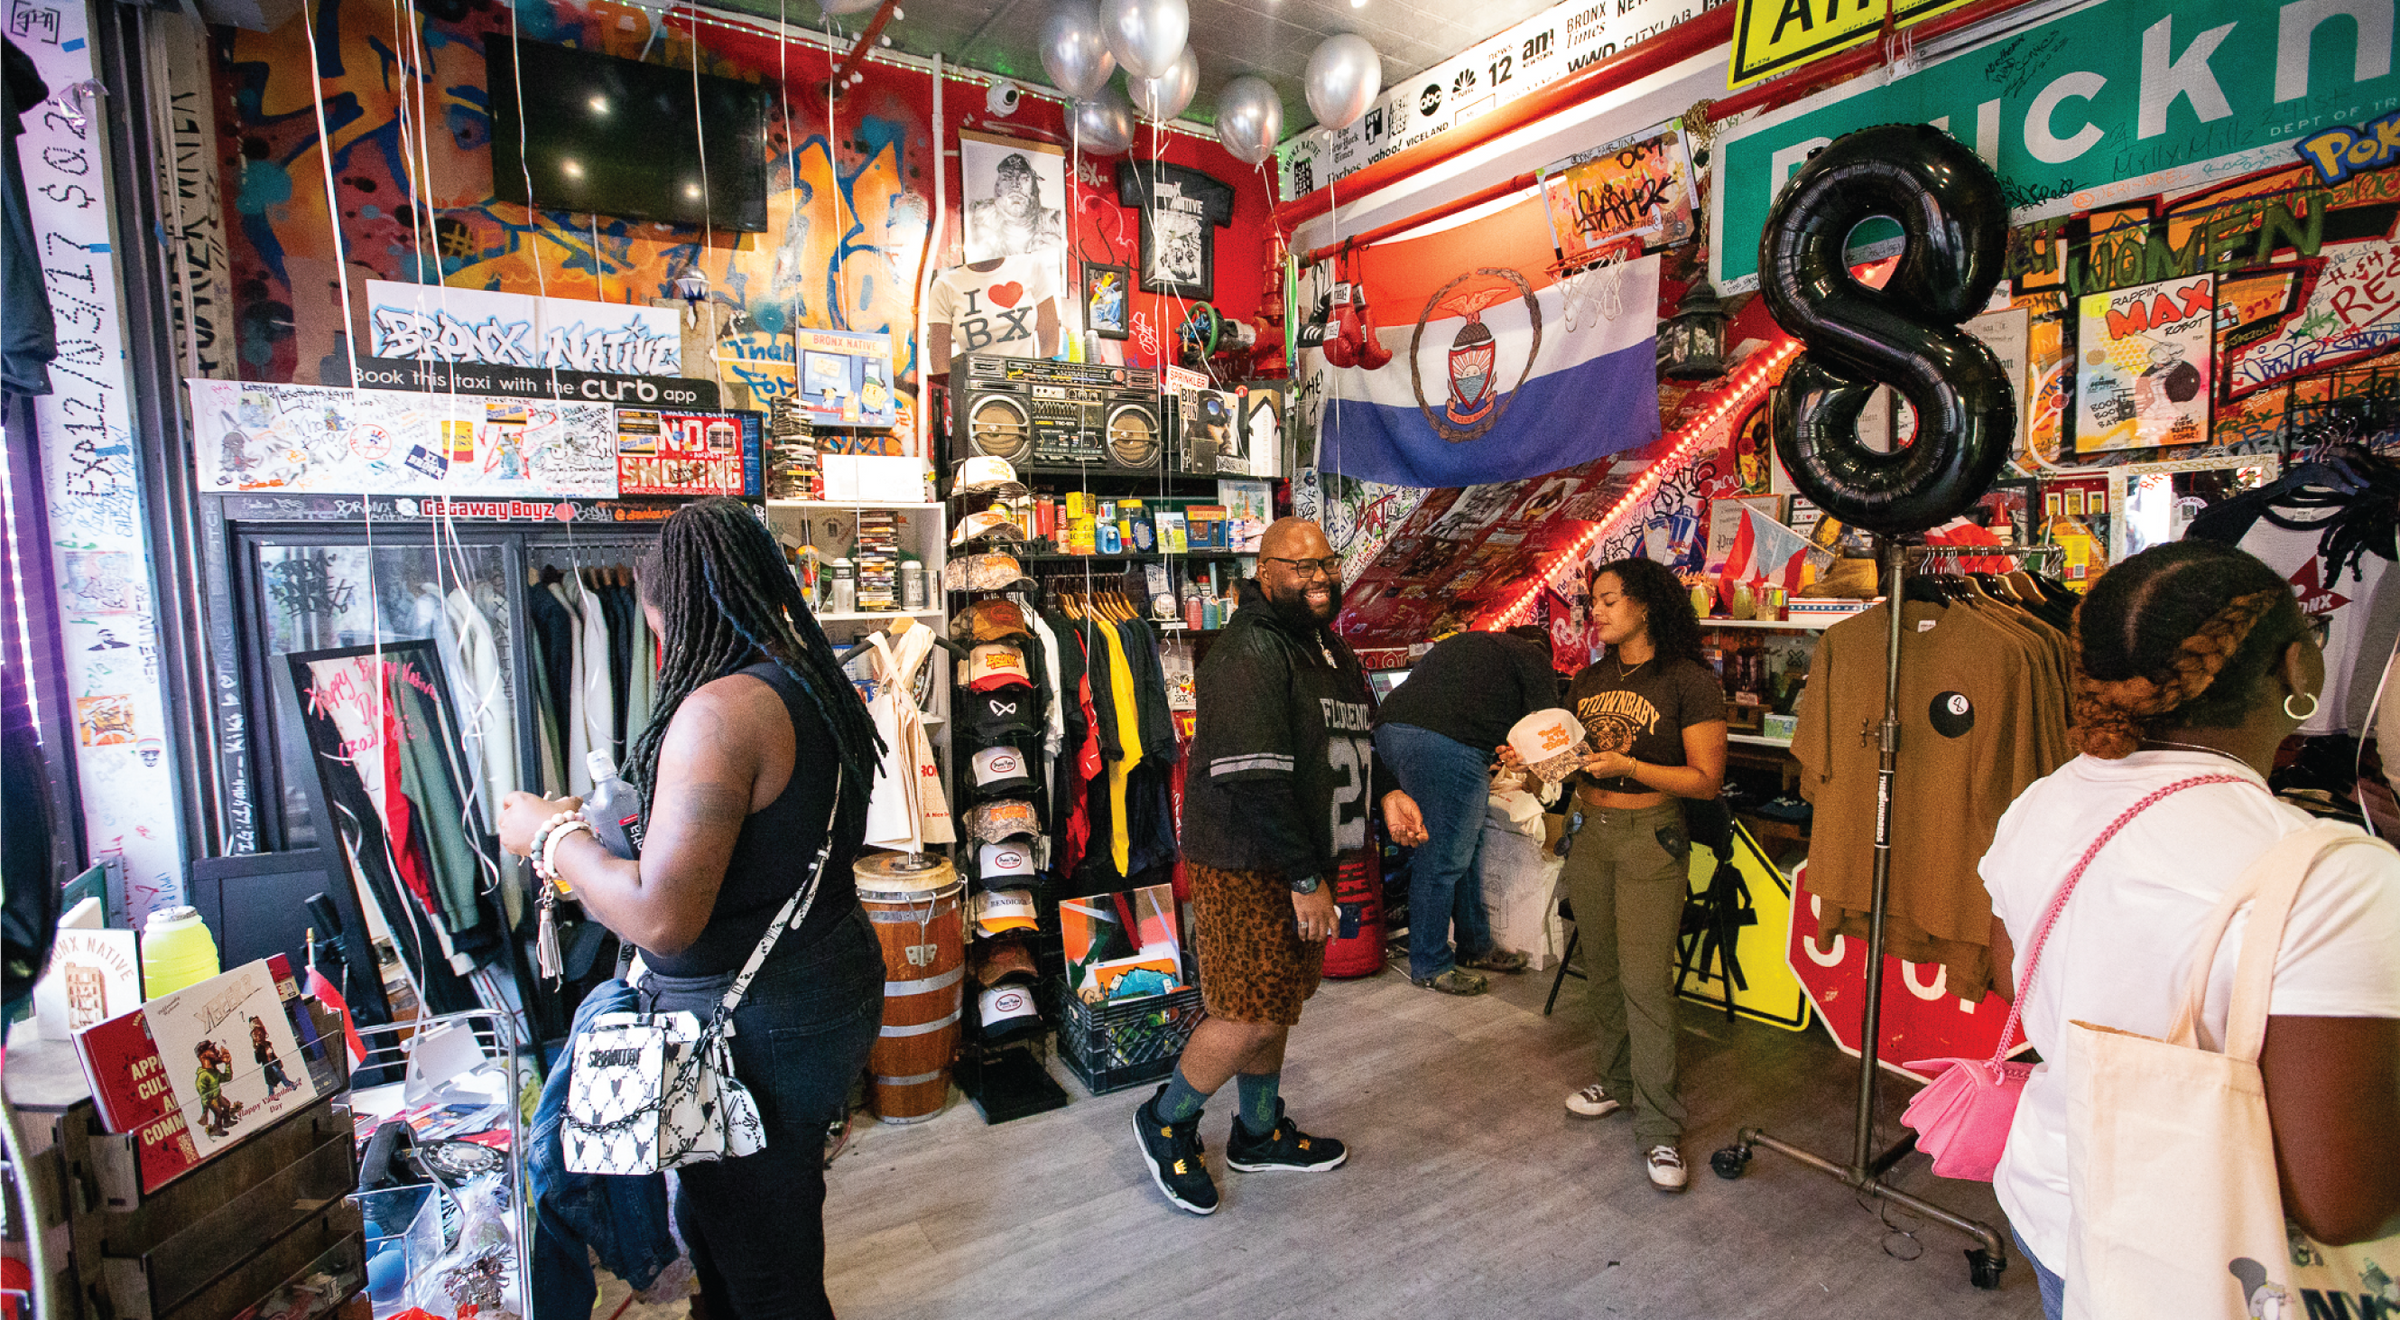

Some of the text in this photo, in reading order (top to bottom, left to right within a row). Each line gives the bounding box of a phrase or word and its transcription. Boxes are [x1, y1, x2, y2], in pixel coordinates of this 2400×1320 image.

[1567, 3, 1607, 33] BRONX
[1488, 55, 1513, 87] 12
[1420, 90, 1441, 110] abc
[1406, 122, 1449, 147] VICELAND
[2270, 115, 2321, 137] DEPT
[2334, 106, 2361, 121] OF
[1284, 146, 1300, 173] BRONX
[1367, 139, 1403, 165] yahoo!
[963, 288, 982, 317] I
[2105, 279, 2214, 341] MAX
[371, 303, 681, 378] BRONX NATIVE
[957, 305, 1033, 352] BX
[1760, 123, 2017, 532] 8
[2165, 314, 2210, 337] ROBOT
[813, 334, 877, 351] BRONX NATIVE
[412, 366, 447, 386] this
[454, 371, 492, 390] taxi
[499, 375, 538, 393] with
[545, 378, 574, 395] the
[581, 378, 659, 401] curb
[663, 388, 698, 405] app
[1170, 370, 1206, 388] SPRINKLER
[1181, 388, 1198, 403] BIG
[1181, 404, 1198, 421] PUN
[658, 418, 704, 452] NO
[621, 457, 742, 489] SMOKING
[87, 936, 135, 982] NATIVE
